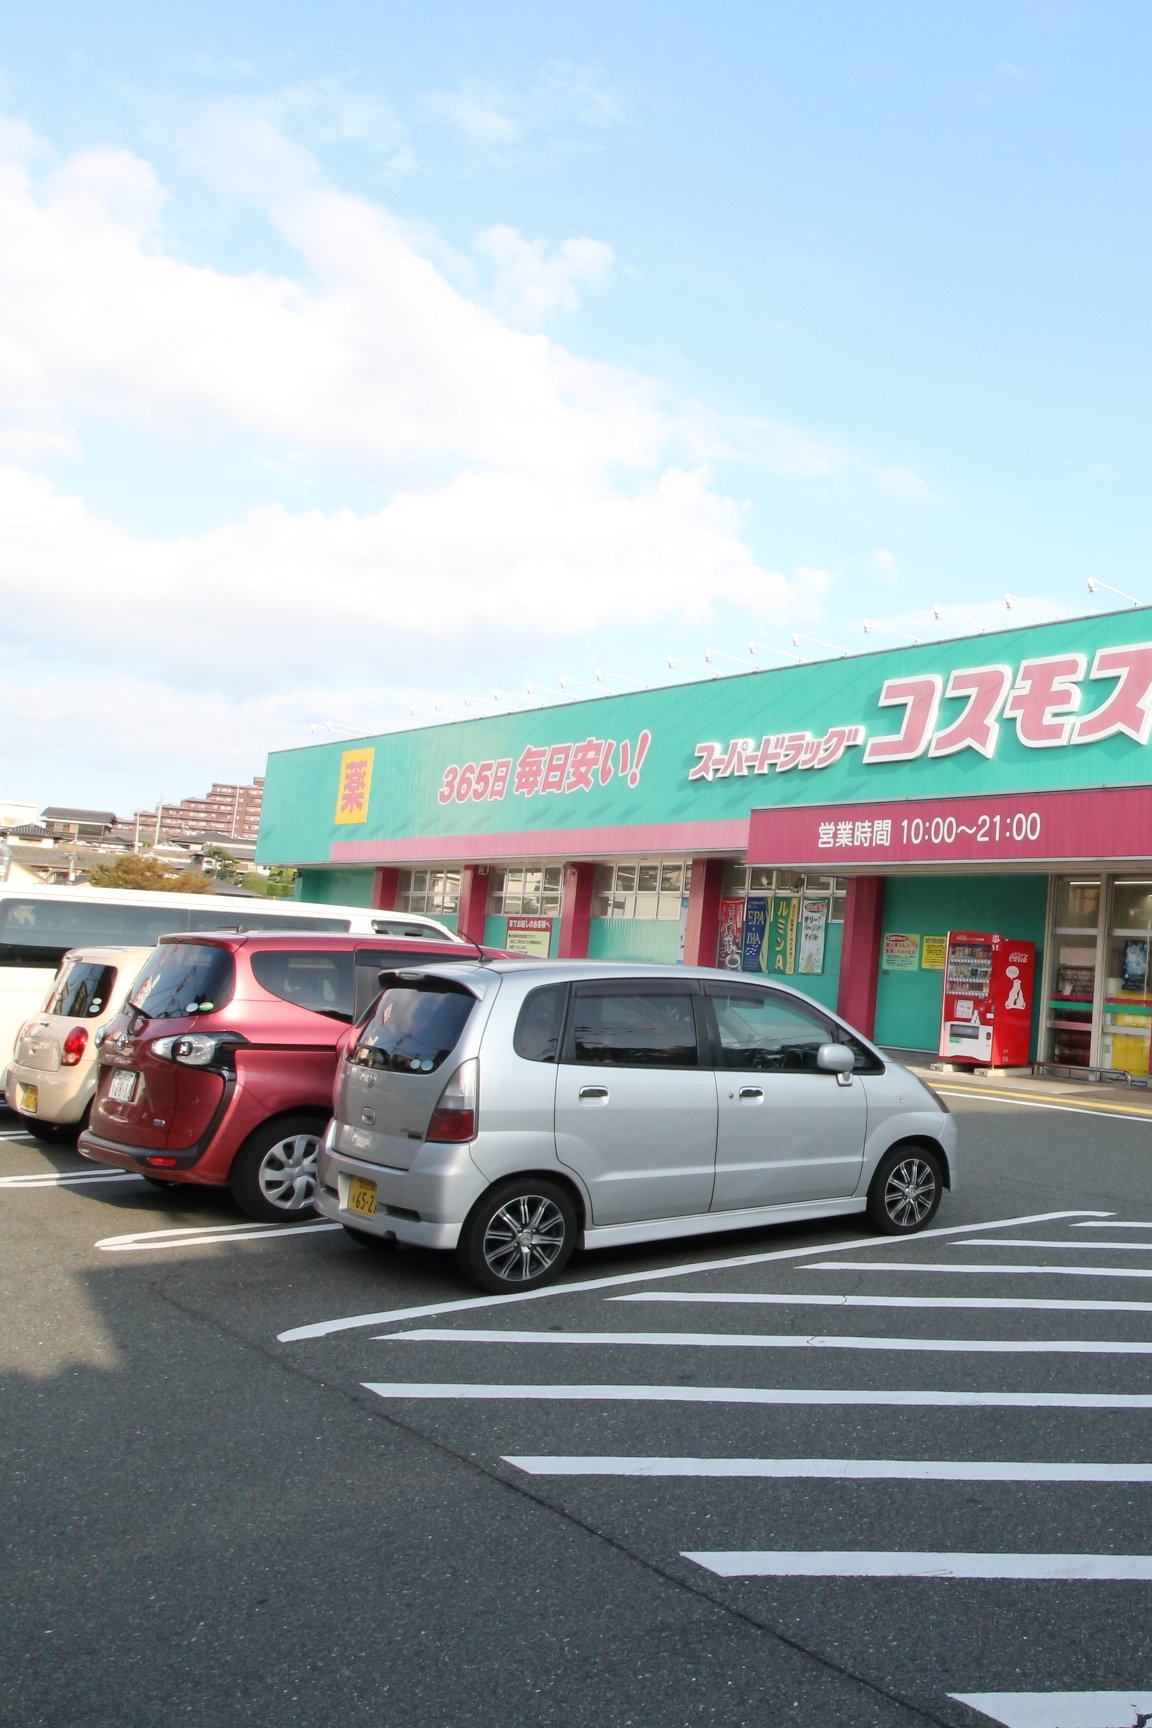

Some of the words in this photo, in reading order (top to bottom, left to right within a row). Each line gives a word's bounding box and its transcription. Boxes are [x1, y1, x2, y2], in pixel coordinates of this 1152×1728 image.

[437, 757, 513, 805] 365日
[513, 729, 652, 797] 毎日安い!
[688, 725, 866, 781] スーパードラッグ
[340, 759, 369, 813] 薬
[817, 819, 893, 848] 営業時間
[747, 910, 765, 925] EPA
